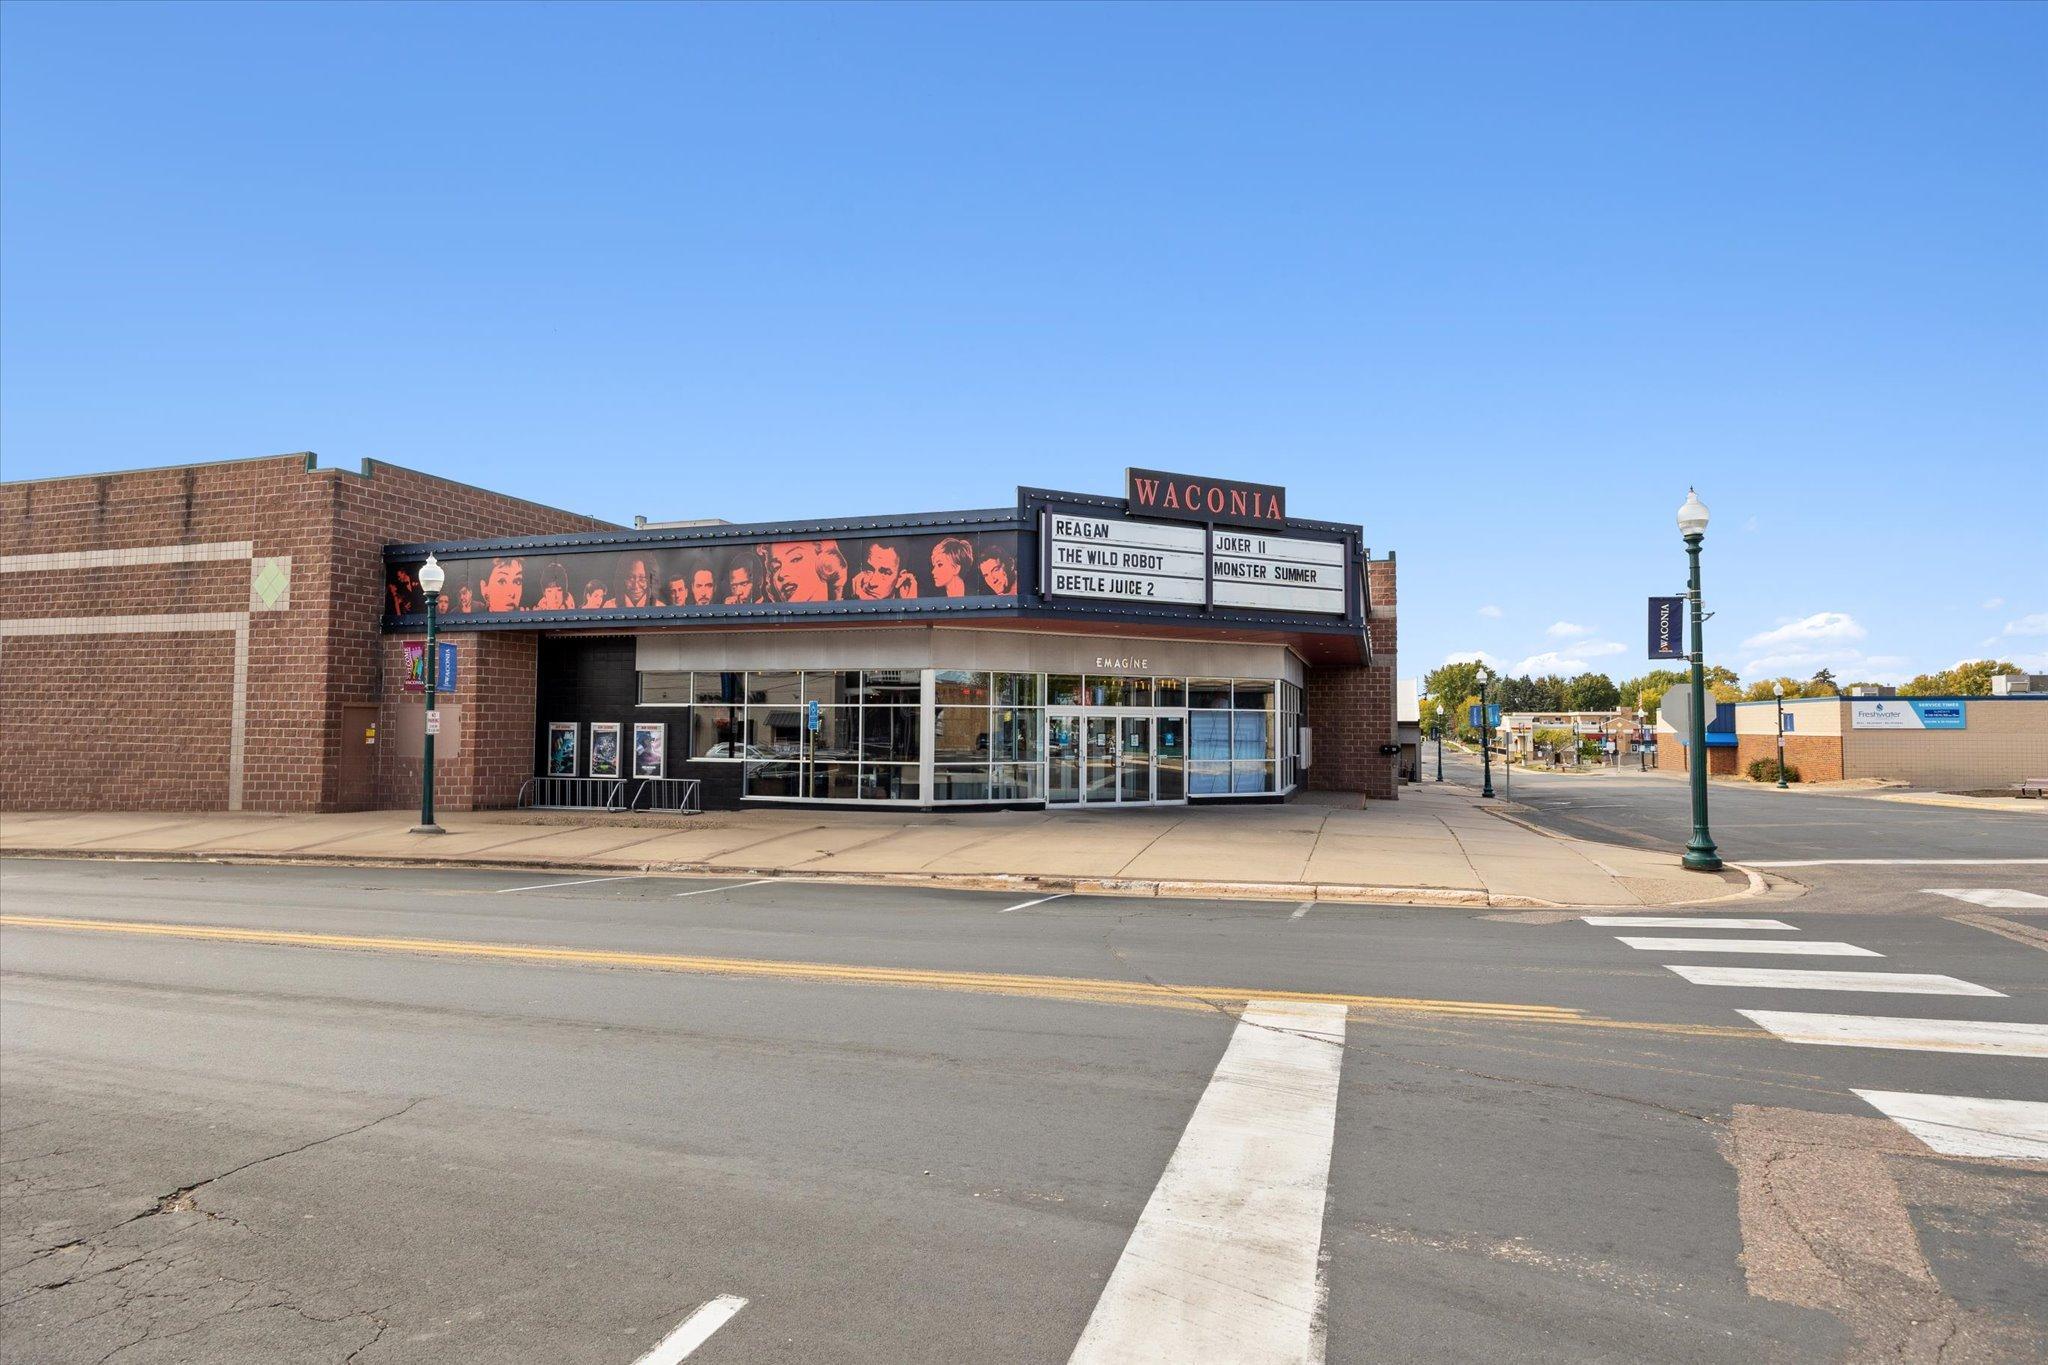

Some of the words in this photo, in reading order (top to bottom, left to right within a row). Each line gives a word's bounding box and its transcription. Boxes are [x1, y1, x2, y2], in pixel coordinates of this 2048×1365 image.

[1135, 478, 1281, 520] WACONIA
[1056, 520, 1109, 538] REAGAN
[1216, 537, 1251, 553] JOKER
[1058, 547, 1082, 563] THE
[1087, 550, 1118, 566] WILD
[1123, 553, 1164, 570] ROBOT
[1214, 562, 1267, 579] MONSTER
[1274, 566, 1317, 583] SUMMER
[1056, 575, 1105, 592] BEETLE
[1109, 579, 1142, 595] JUICE
[1147, 582, 1154, 596] 2
[1660, 604, 1669, 648] WACONIA
[1095, 656, 1148, 669] EMAGINE
[1858, 710, 1901, 718] Freshwater
